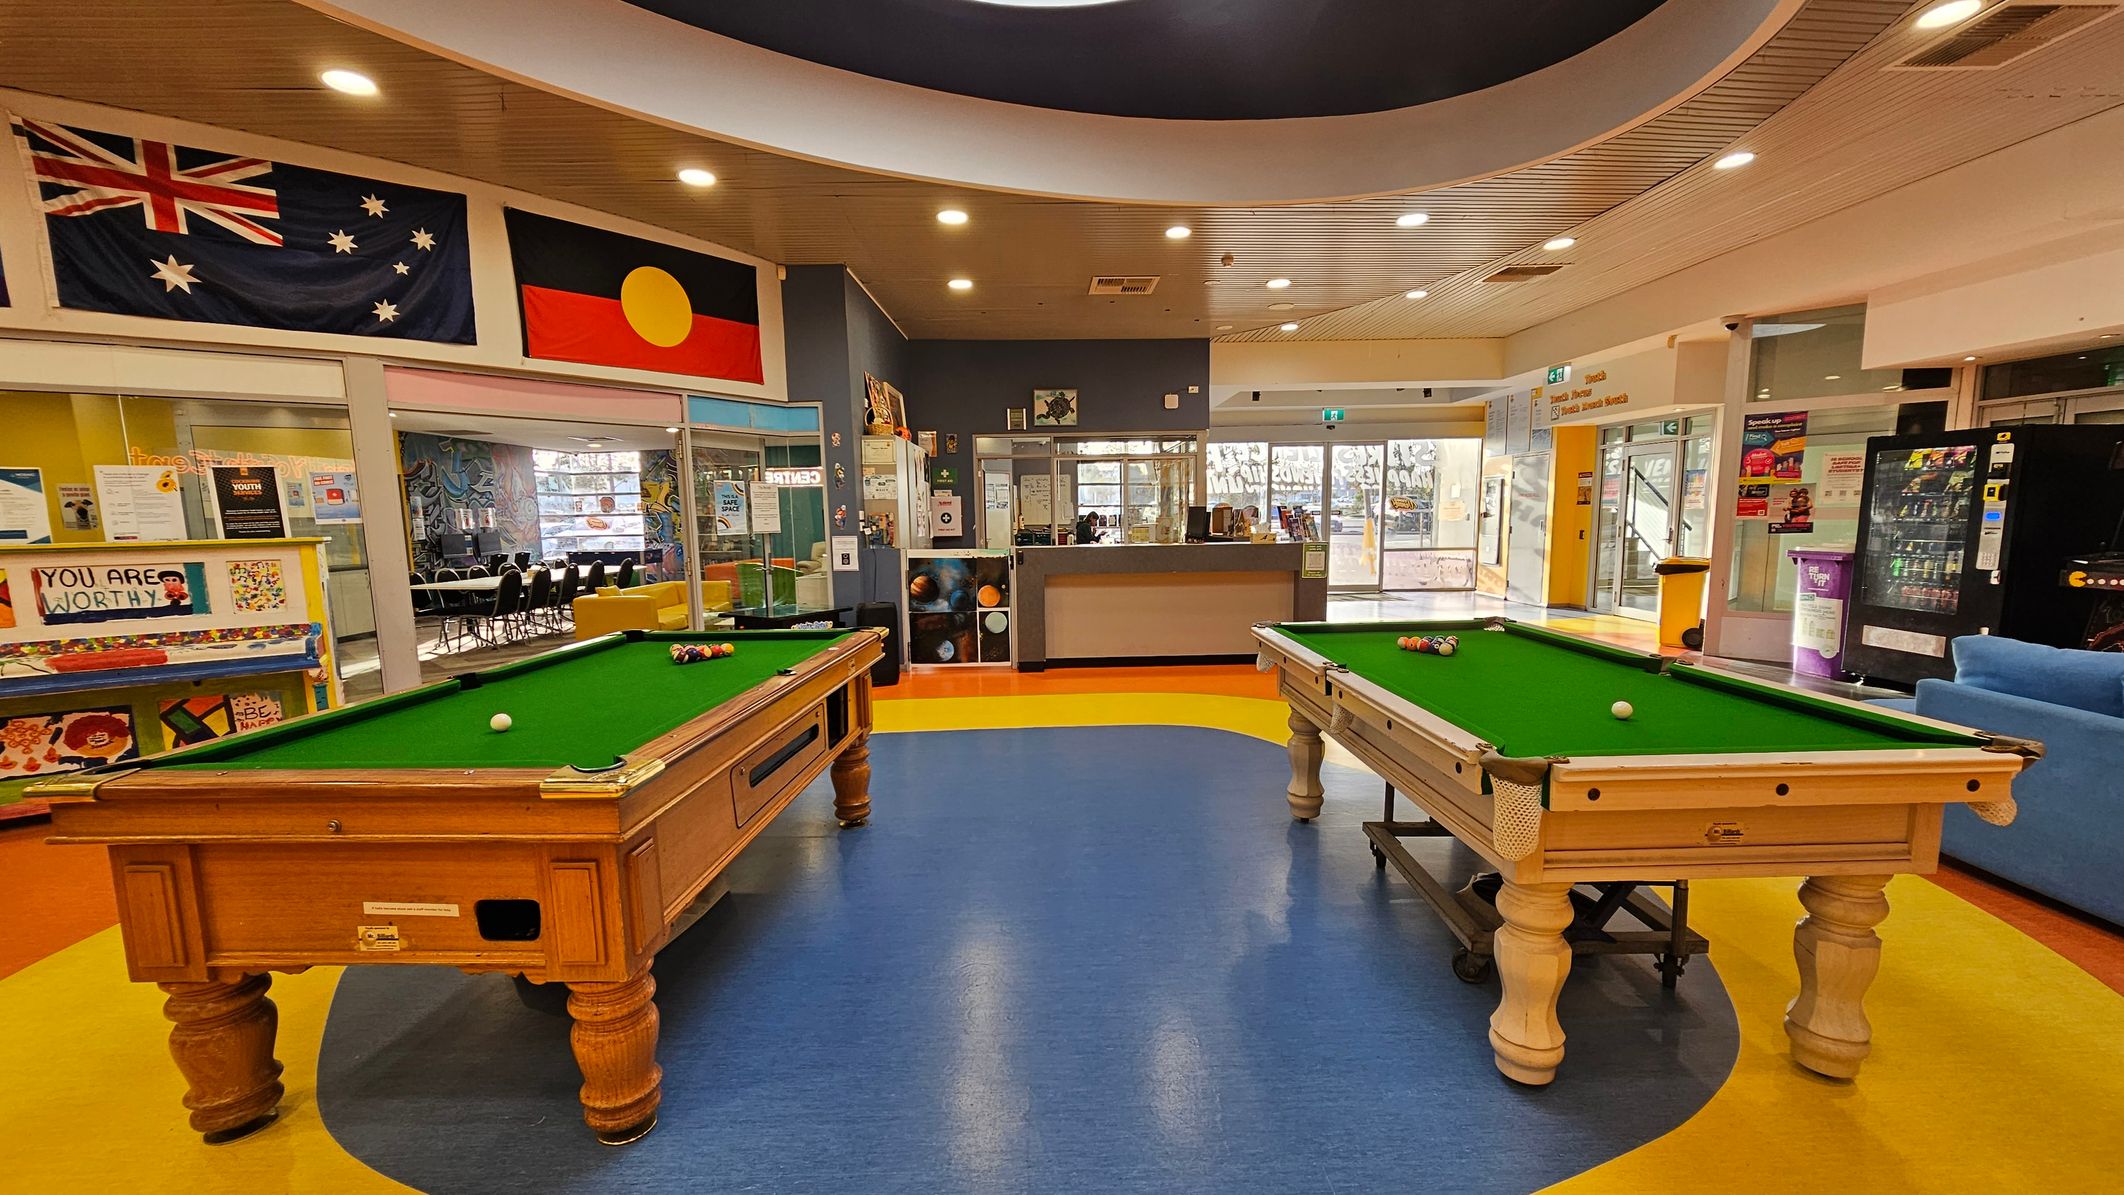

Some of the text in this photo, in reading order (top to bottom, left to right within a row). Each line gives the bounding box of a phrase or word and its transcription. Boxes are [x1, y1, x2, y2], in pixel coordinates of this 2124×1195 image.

[1748, 418, 1771, 426] Speak
[232, 483, 262, 491] YOUTH
[41, 567, 161, 588] YOU ARE
[41, 589, 156, 614] WORTHY
[244, 705, 271, 720] BE
